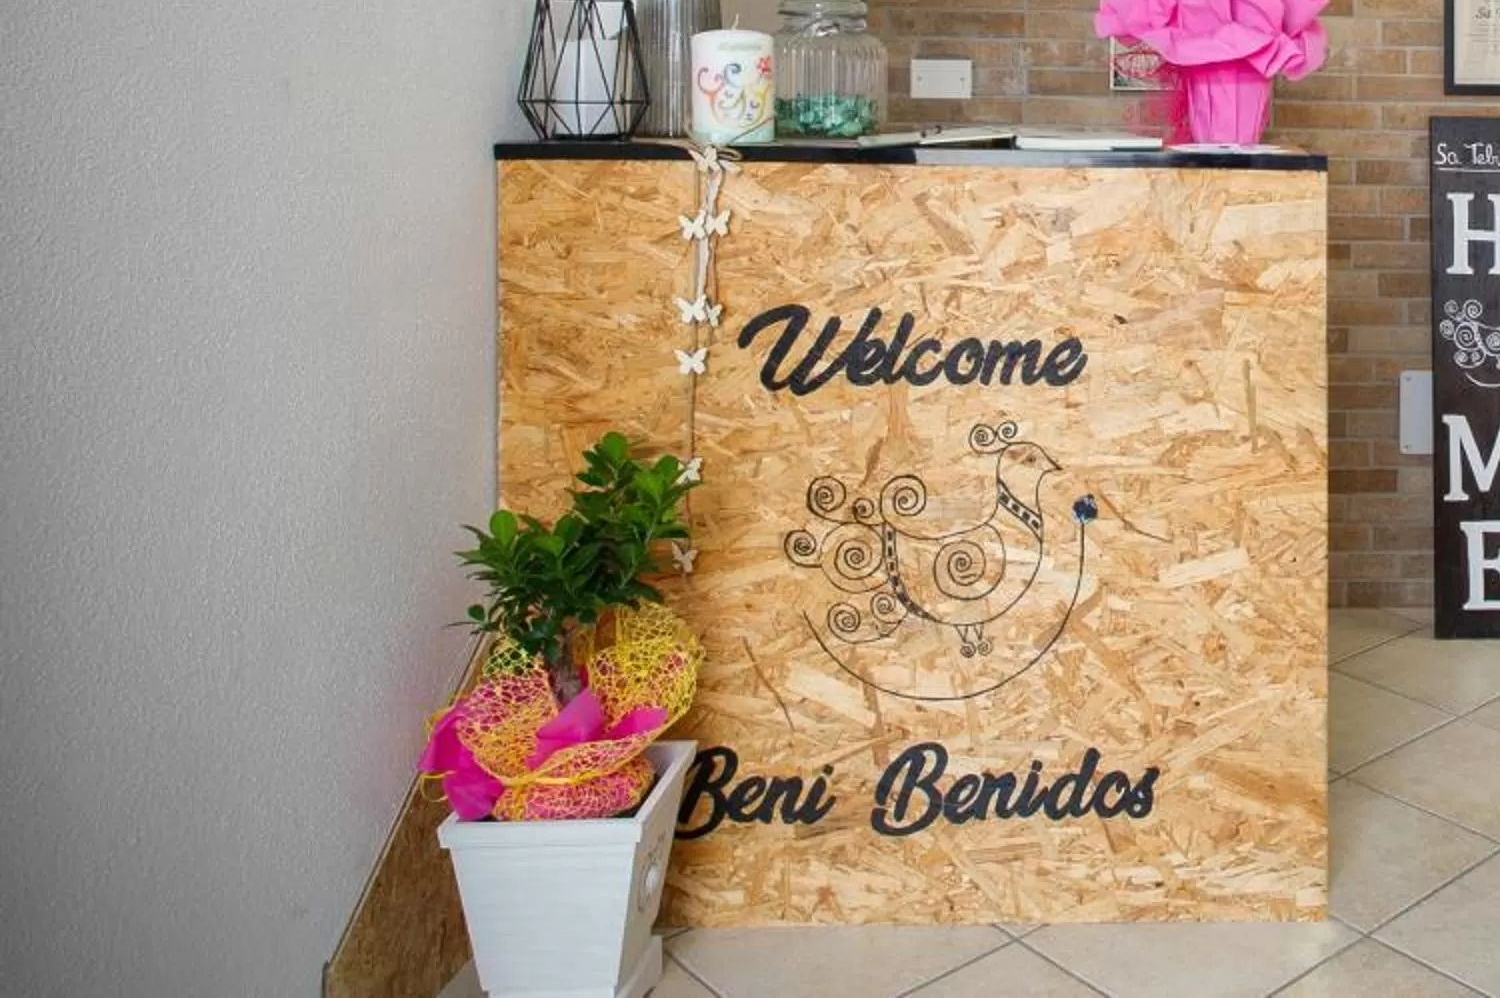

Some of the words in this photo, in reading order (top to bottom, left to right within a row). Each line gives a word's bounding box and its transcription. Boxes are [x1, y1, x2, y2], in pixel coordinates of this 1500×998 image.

[1433, 142, 1462, 166] Sa
[736, 303, 1089, 397] Welcome
[674, 745, 836, 840] Beni
[870, 741, 1161, 838] Benidos
